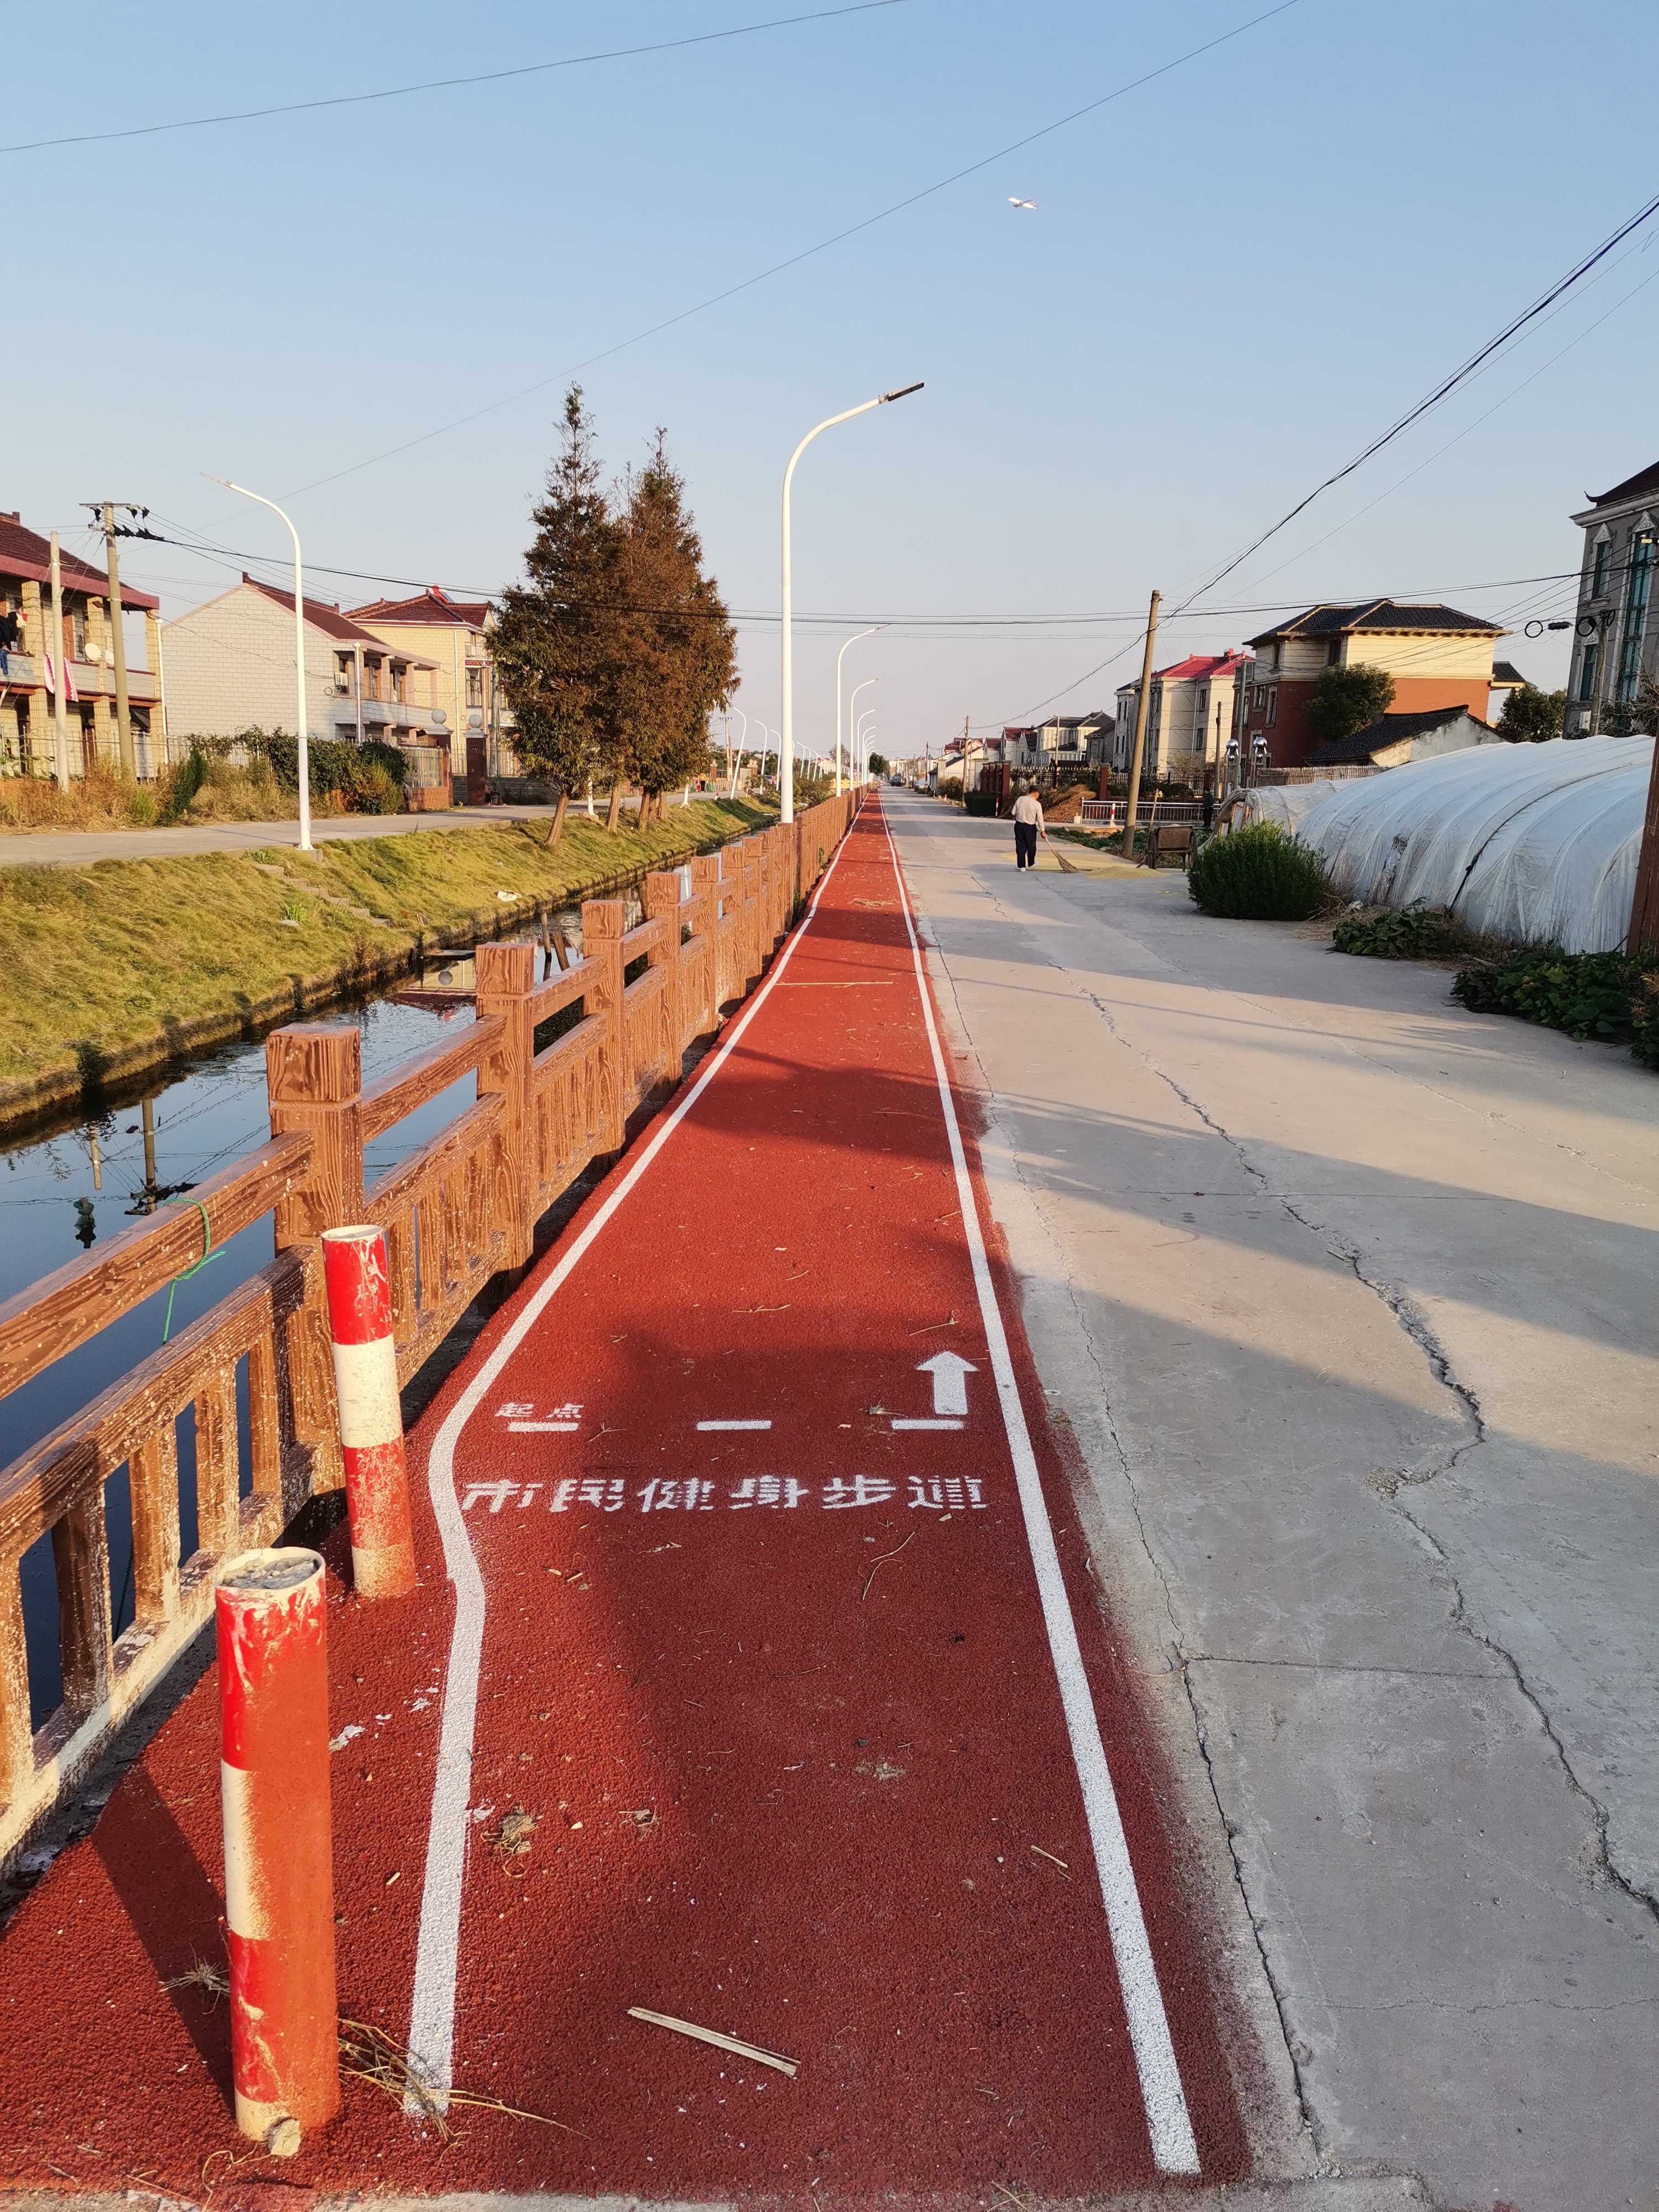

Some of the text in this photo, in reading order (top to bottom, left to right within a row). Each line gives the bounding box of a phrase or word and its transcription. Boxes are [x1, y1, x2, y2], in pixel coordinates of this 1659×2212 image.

[495, 1402, 584, 1418] 起点
[461, 1474, 987, 1512] 市民健身步道
